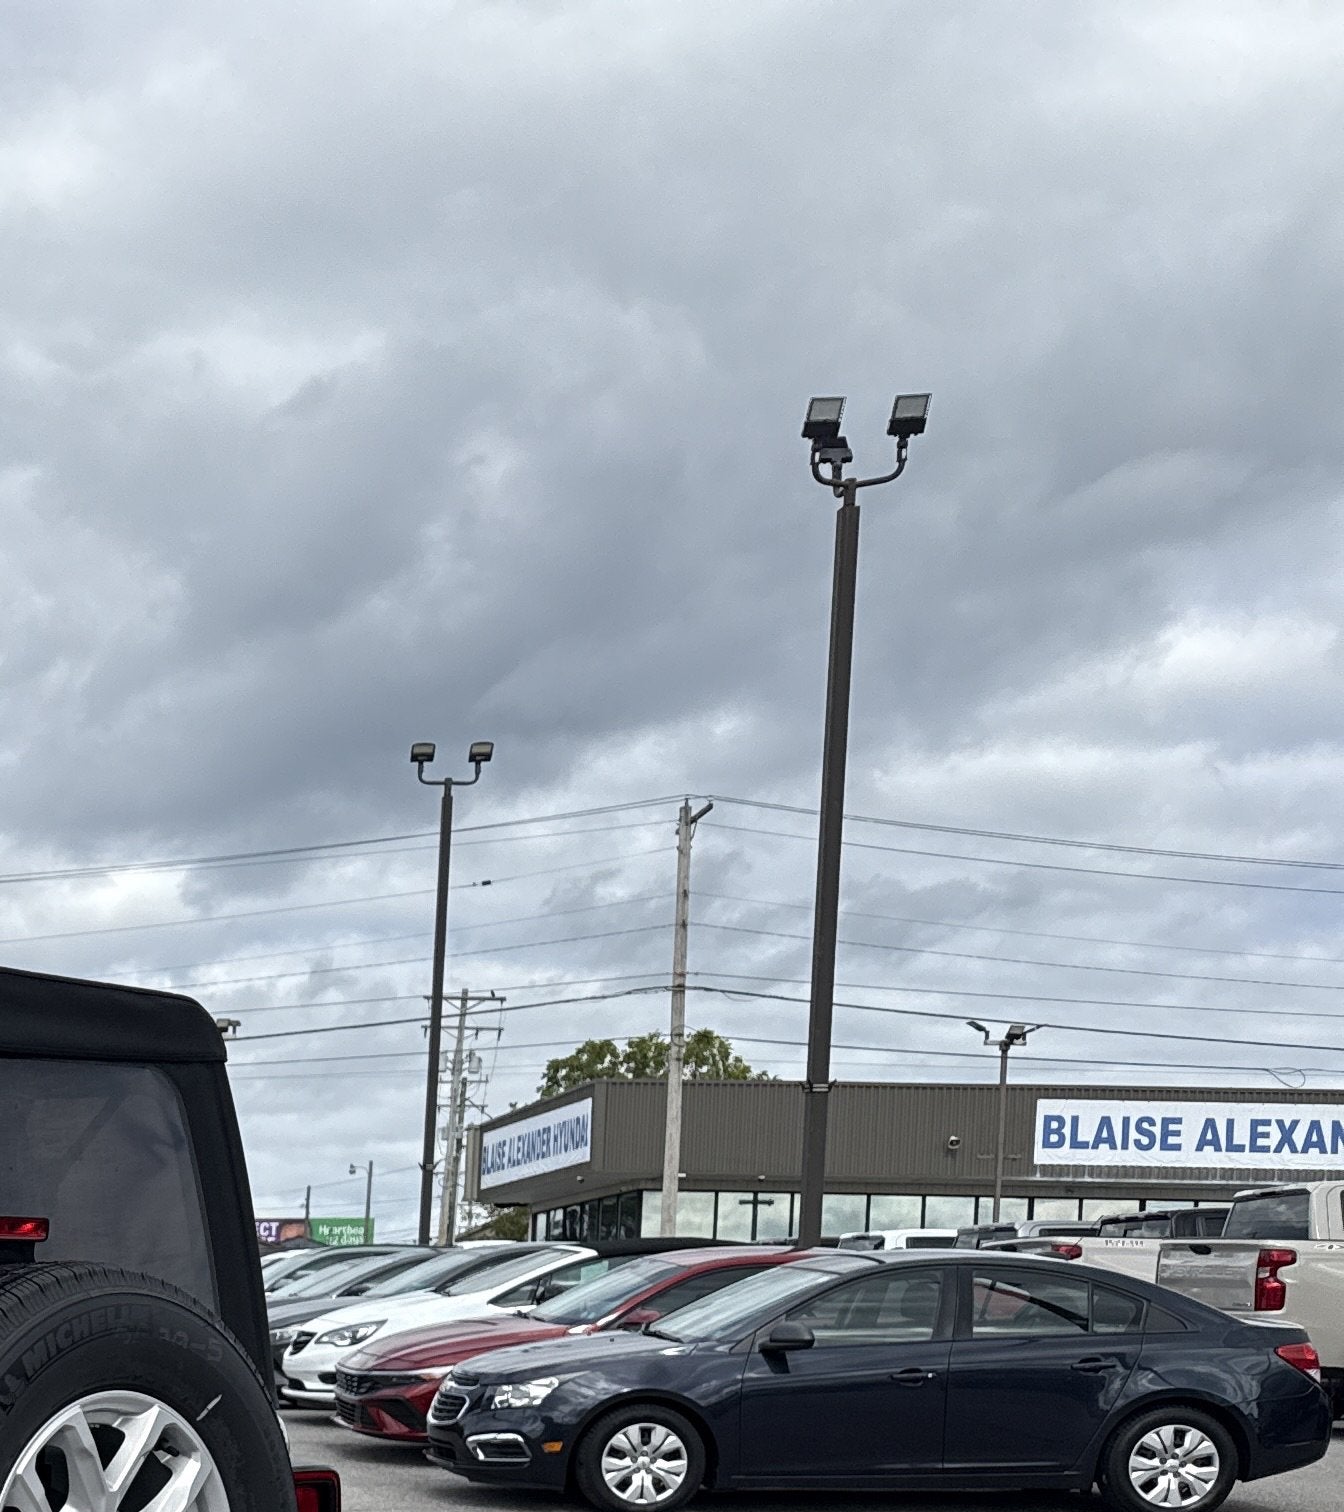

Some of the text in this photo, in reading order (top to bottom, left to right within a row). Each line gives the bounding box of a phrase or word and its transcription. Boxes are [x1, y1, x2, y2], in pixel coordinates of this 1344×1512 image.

[481, 1113, 589, 1176] BLAISE ALEXANDER HYUNDAI
[1042, 1115, 1183, 1151] BLAISE
